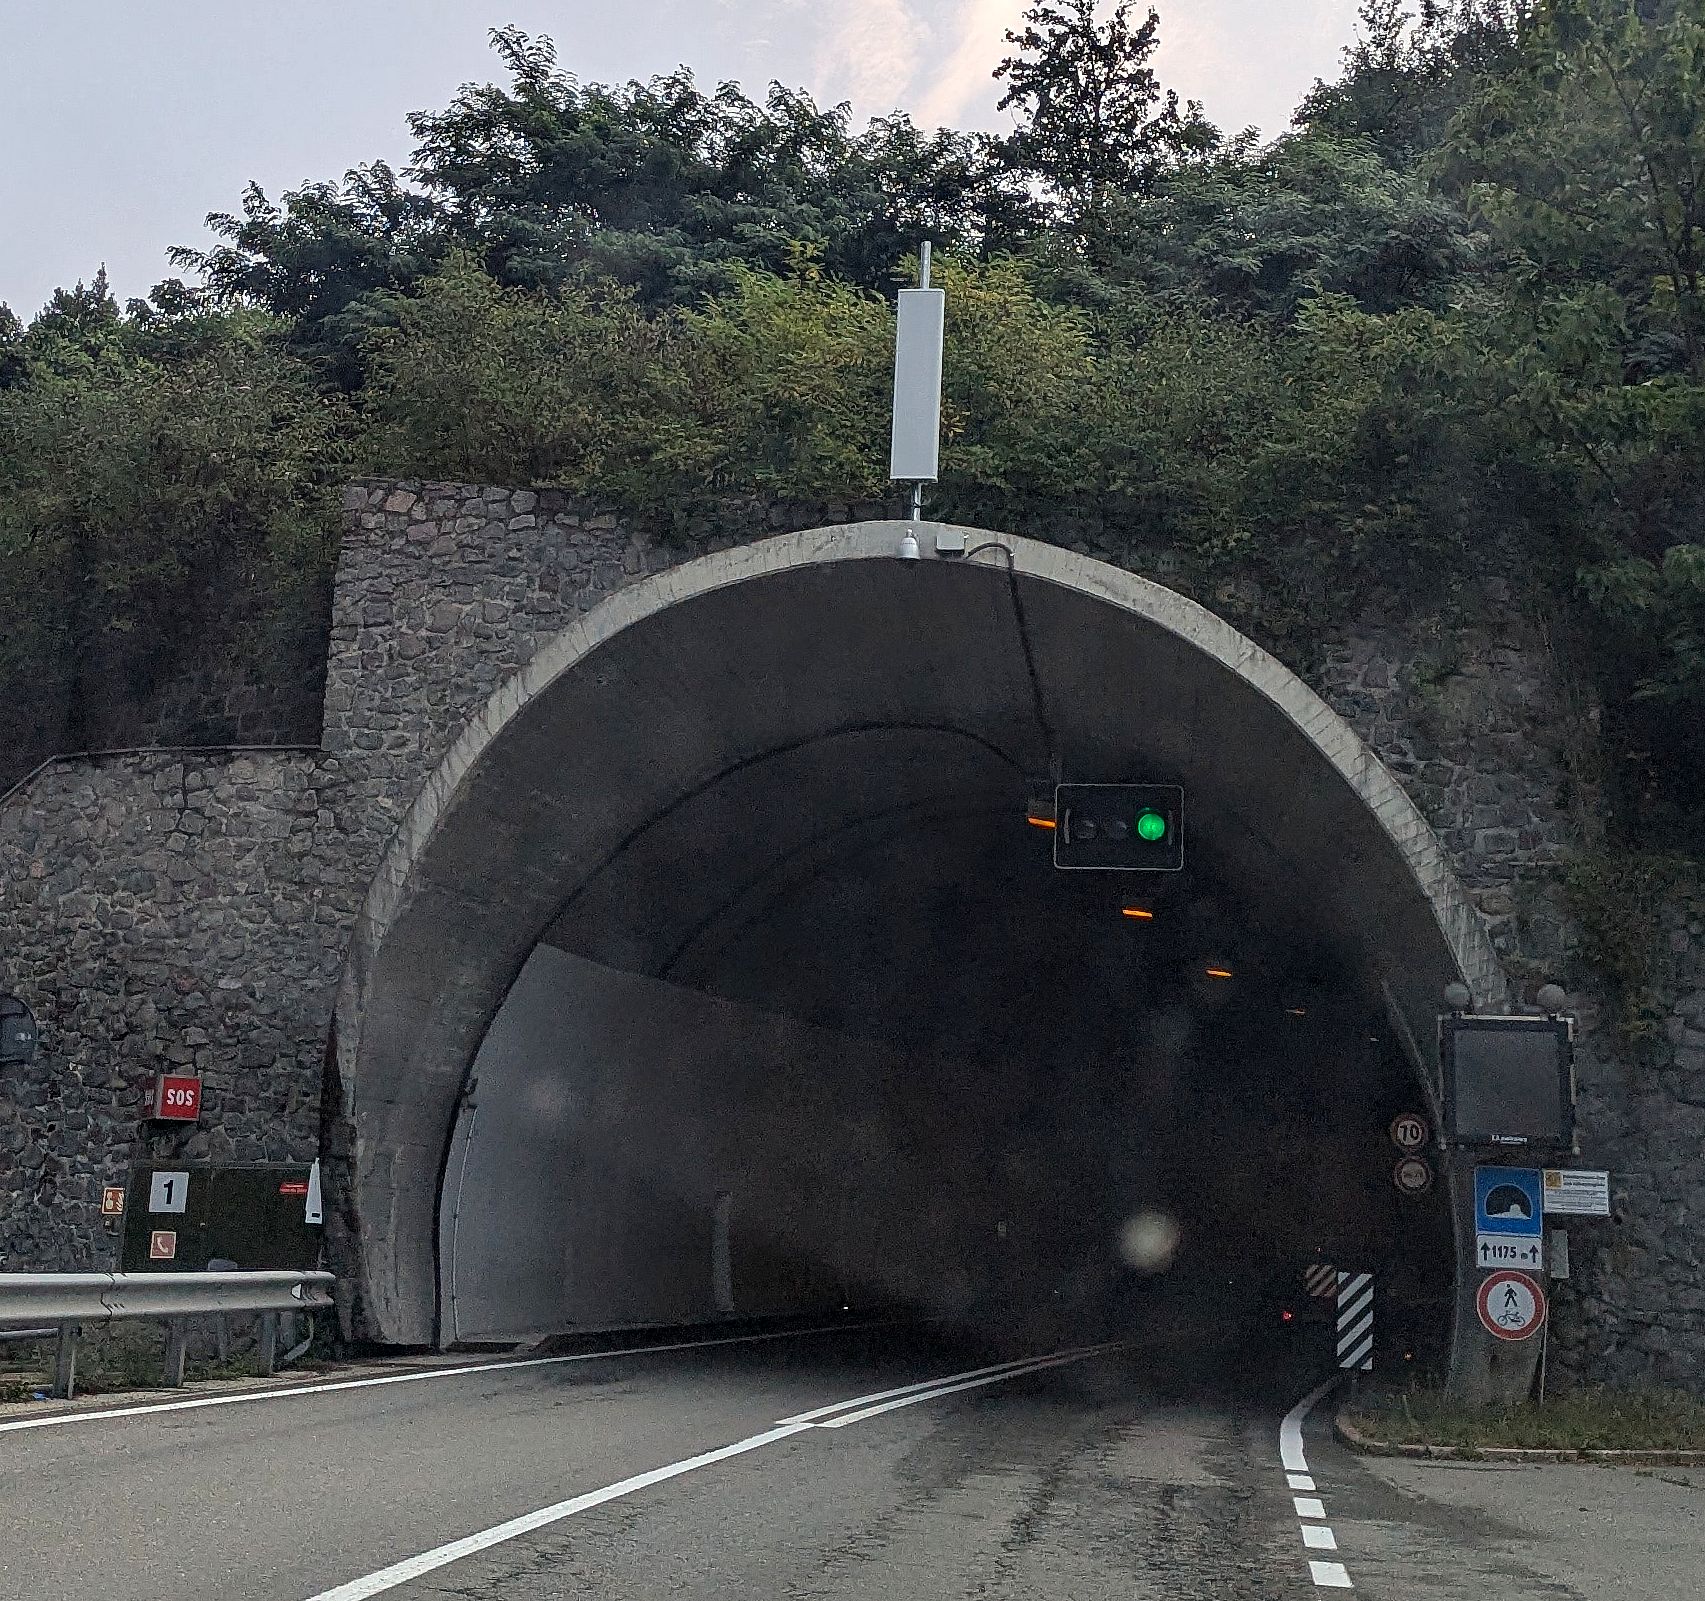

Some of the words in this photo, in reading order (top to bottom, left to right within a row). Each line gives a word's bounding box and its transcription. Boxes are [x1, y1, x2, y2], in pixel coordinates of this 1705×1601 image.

[166, 1088, 195, 1107] SOS
[1400, 1124, 1420, 1141] 70
[163, 1180, 174, 1204] 1
[1492, 1245, 1517, 1258] 1175
